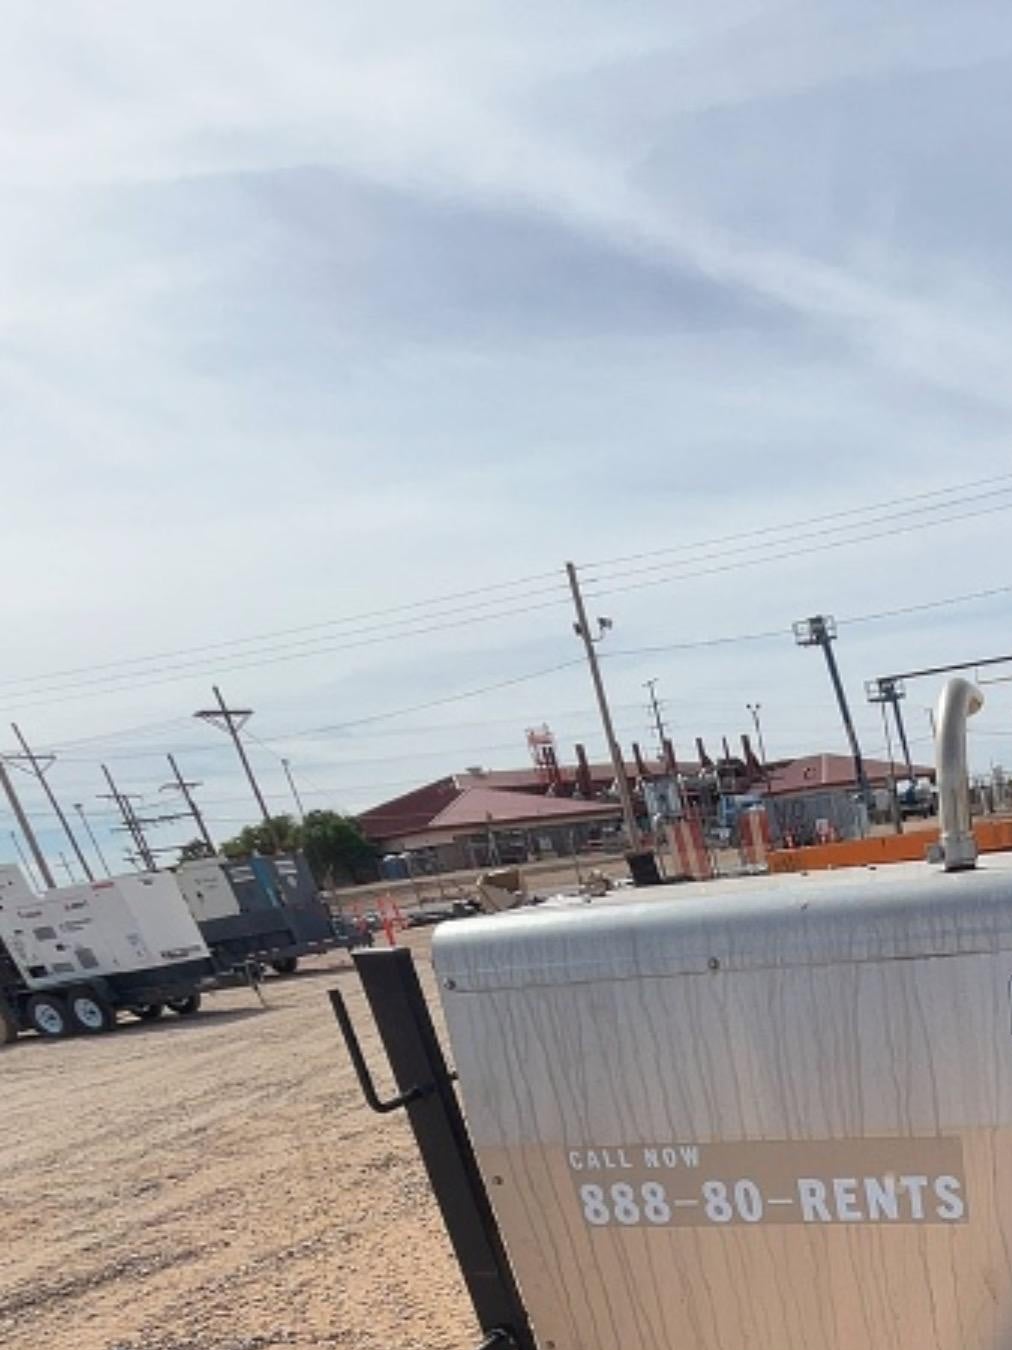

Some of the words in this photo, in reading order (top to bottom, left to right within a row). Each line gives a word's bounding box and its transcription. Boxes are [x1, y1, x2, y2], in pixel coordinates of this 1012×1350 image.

[568, 1149, 634, 1171] CALL
[643, 1146, 699, 1169] NOW
[579, 1174, 965, 1226] 888-80-RENTS
